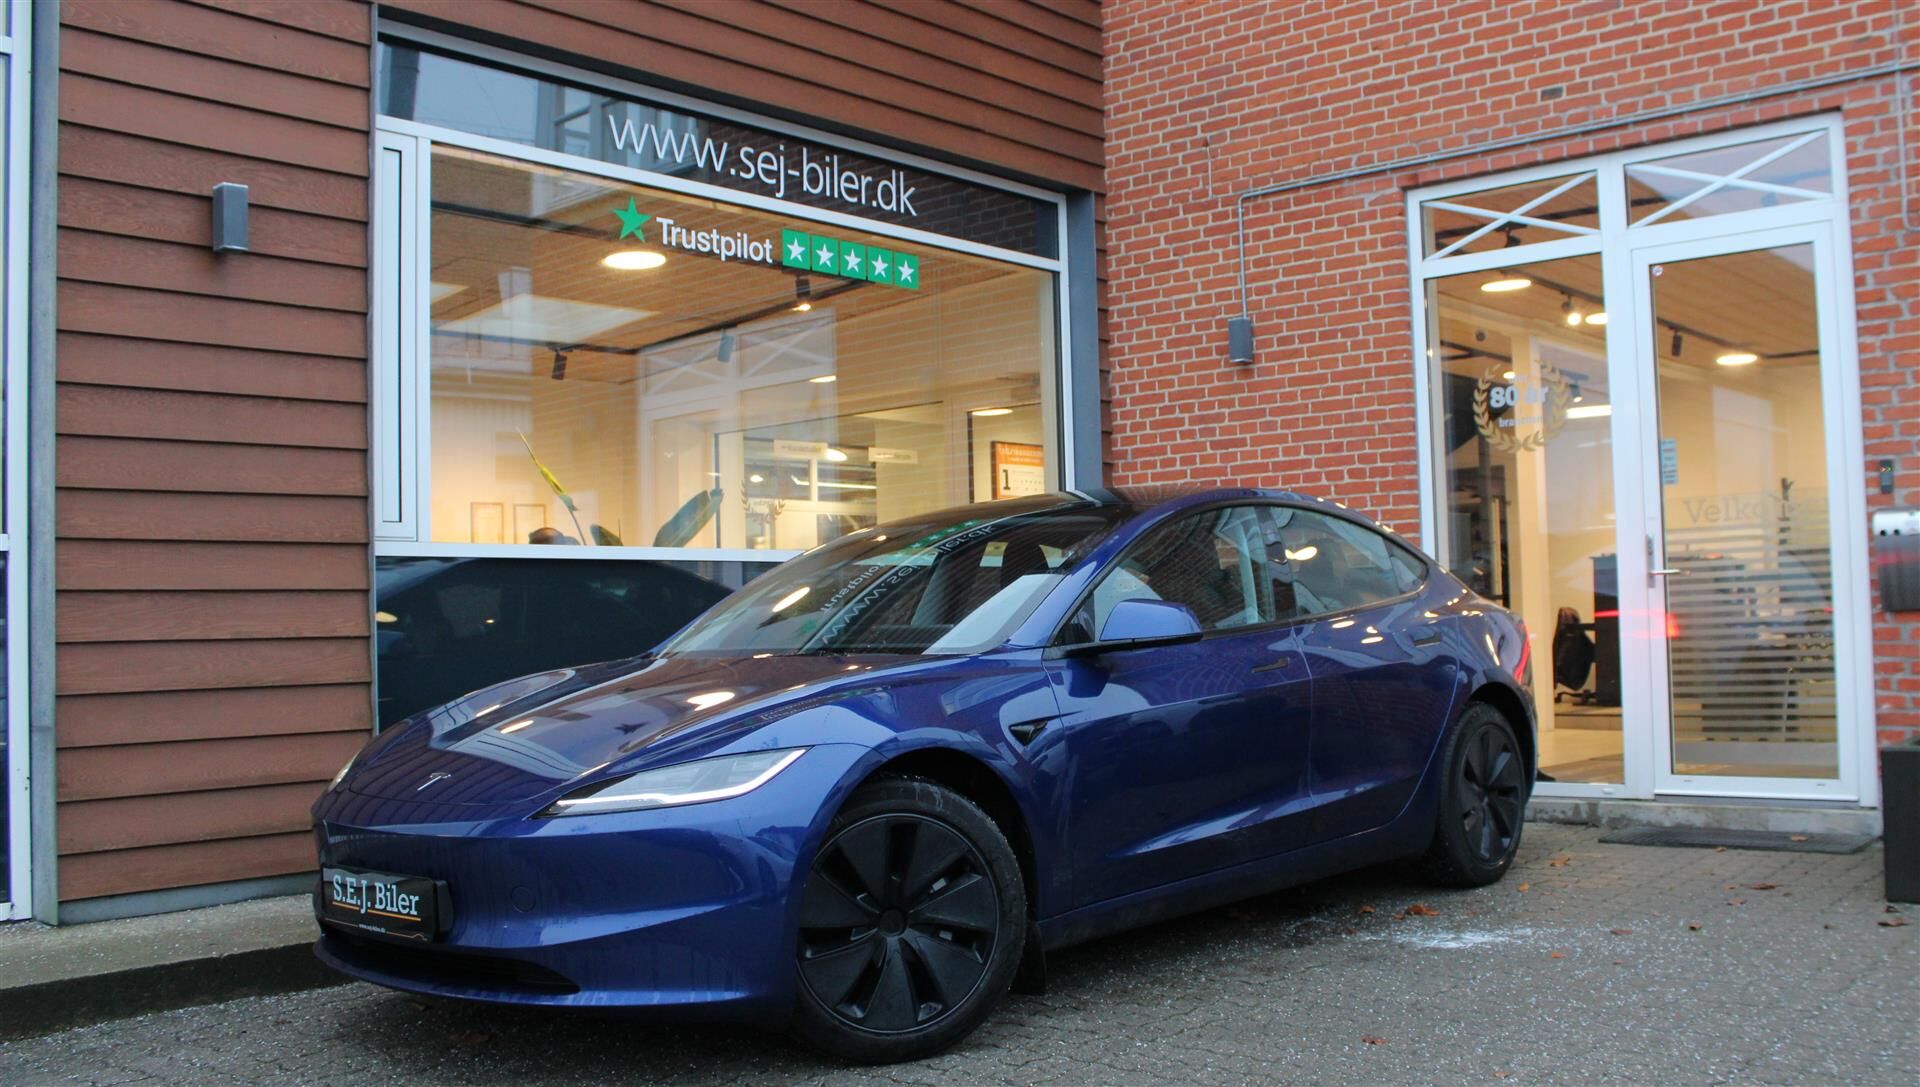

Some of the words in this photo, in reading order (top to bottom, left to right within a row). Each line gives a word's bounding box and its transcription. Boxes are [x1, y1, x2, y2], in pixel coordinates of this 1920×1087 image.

[609, 115, 918, 216] www.sej-biler.dk
[656, 216, 774, 264] Trustpilot
[1490, 385, 1518, 408] 80
[333, 874, 371, 914] S.E.J.
[375, 882, 420, 915] Biler
